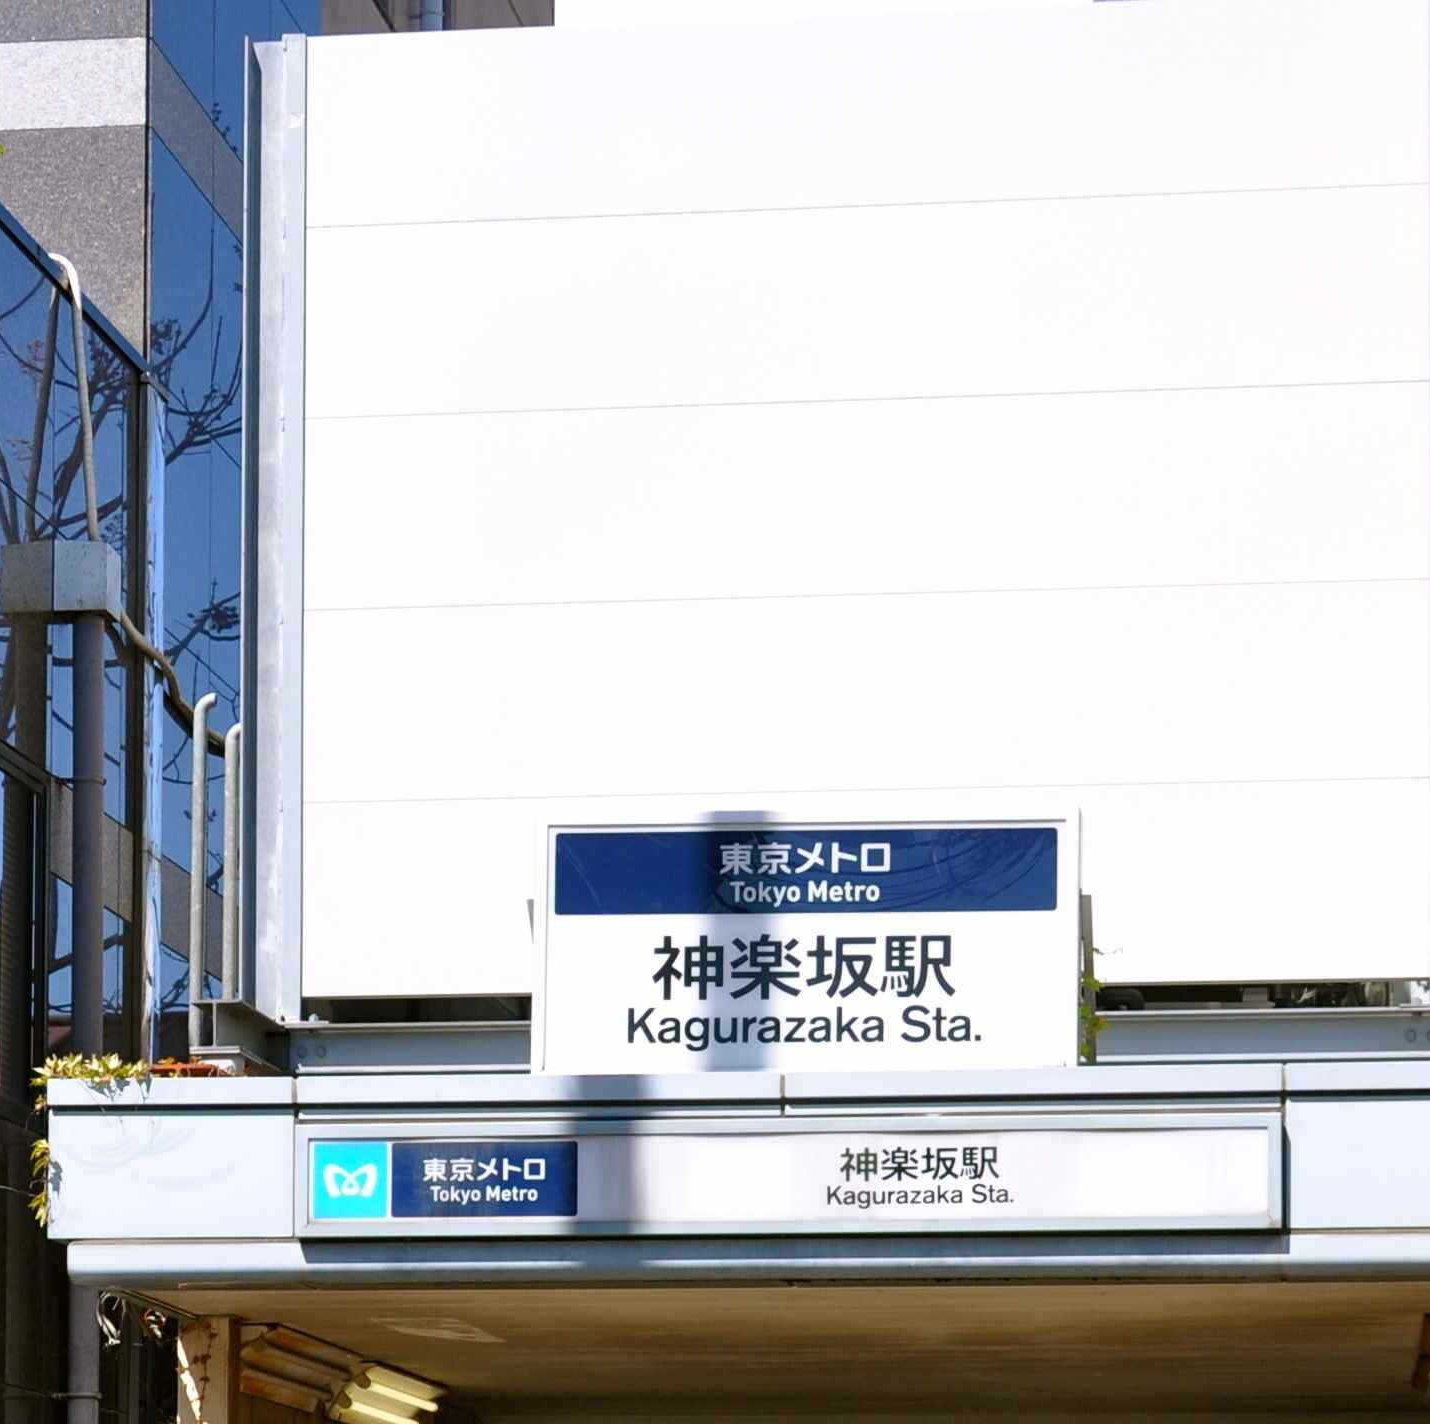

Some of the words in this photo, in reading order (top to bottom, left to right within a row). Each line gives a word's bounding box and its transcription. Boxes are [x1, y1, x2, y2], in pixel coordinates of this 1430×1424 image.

[719, 841, 891, 876] 東京メトロ
[730, 880, 801, 909] Tokyo
[807, 880, 881, 904] Metro
[652, 935, 957, 1000] 神楽坂駅
[627, 1007, 885, 1052] Kagurazaka
[901, 1004, 983, 1043] Sta.
[423, 1156, 547, 1182] 東京メトロ
[839, 1146, 1000, 1182] 神楽坂駅
[431, 1184, 479, 1205] Tokyo
[485, 1184, 539, 1202] Metro
[826, 1184, 966, 1209] Kagurazaka
[972, 1183, 1015, 1206] Sta.
